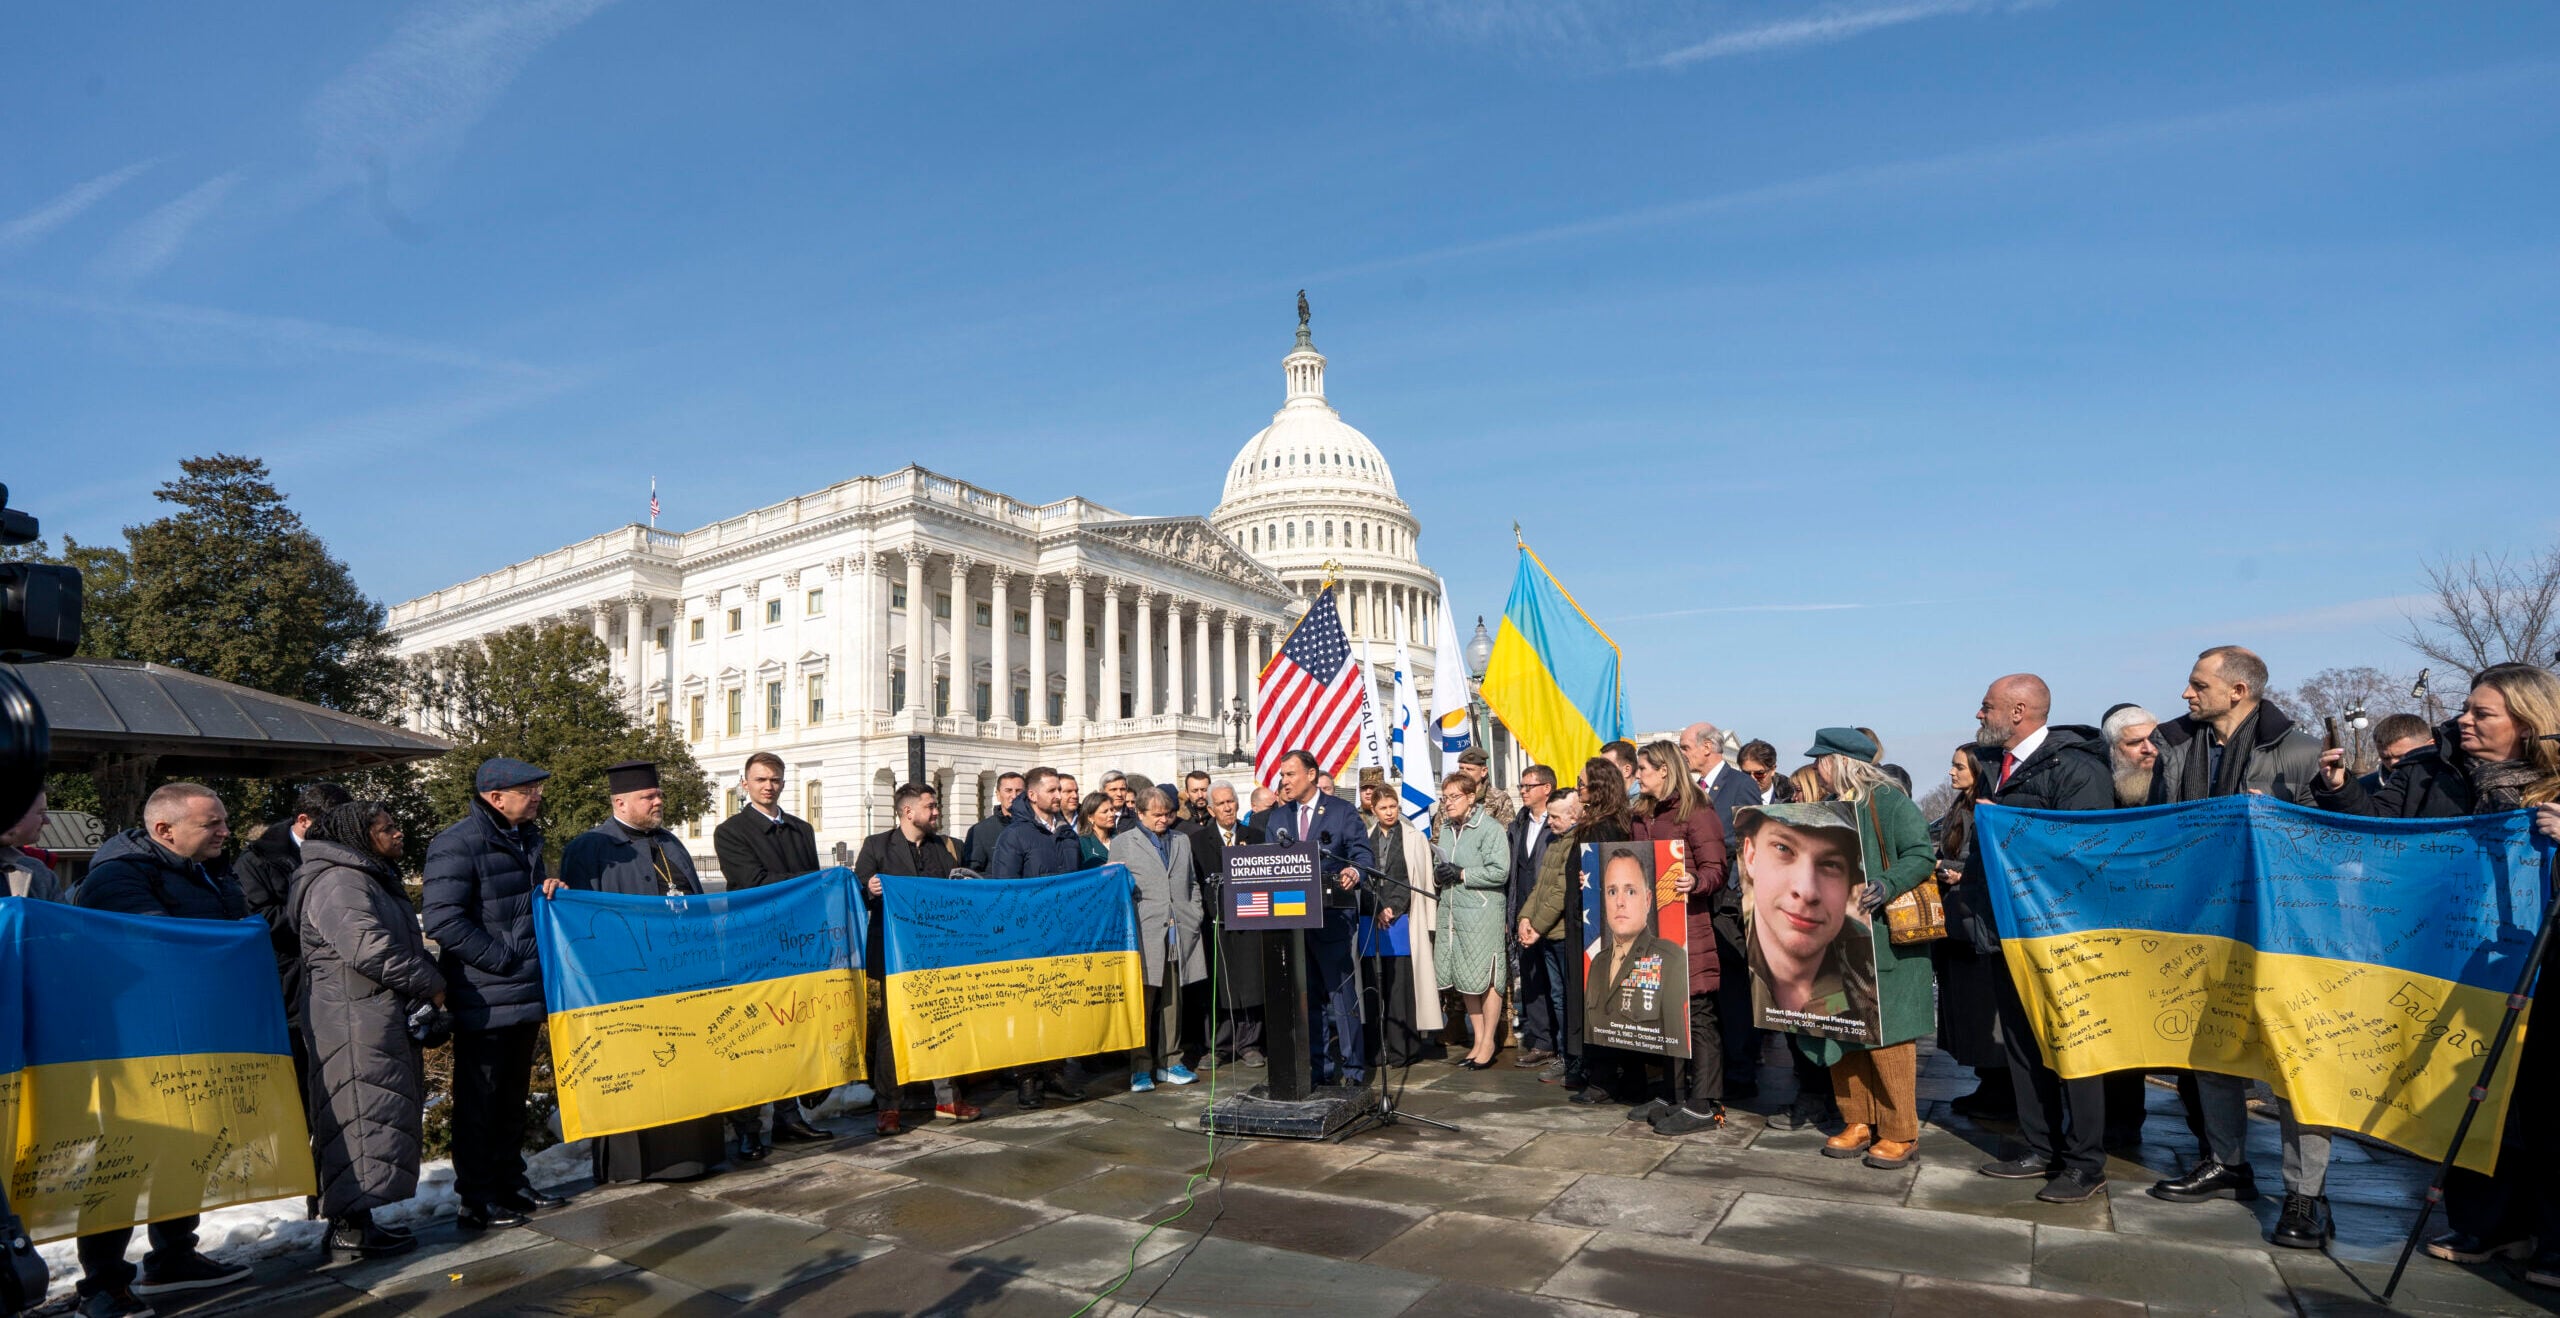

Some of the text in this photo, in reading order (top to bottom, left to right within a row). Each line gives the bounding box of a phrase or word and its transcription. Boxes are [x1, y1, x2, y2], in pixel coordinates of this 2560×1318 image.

[1366, 731, 1379, 752] TO
[2372, 832, 2408, 859] help
[2419, 840, 2465, 860] stop
[1230, 853, 1312, 867] CONGRESSIONAL
[1231, 864, 1312, 877] UKRAINE CAUCUS
[778, 930, 816, 960] Hope
[990, 965, 1014, 976] school
[2159, 954, 2183, 979] PRAY
[2317, 966, 2367, 994] Ukraine
[764, 990, 828, 1027] War
[1766, 1007, 1784, 1016] Robert
[1808, 1013, 1830, 1022] Edward
[1593, 1026, 1616, 1035] December
[1638, 1033, 1657, 1041] October
[1665, 1037, 1679, 1045] 2024
[1766, 1015, 1793, 1025] December
[1821, 1023, 1843, 1034] January
[1850, 1027, 1867, 1036] 2025
[706, 1031, 727, 1047] Stop
[714, 1039, 738, 1059] Save
[2337, 1039, 2402, 1064] Freedom
